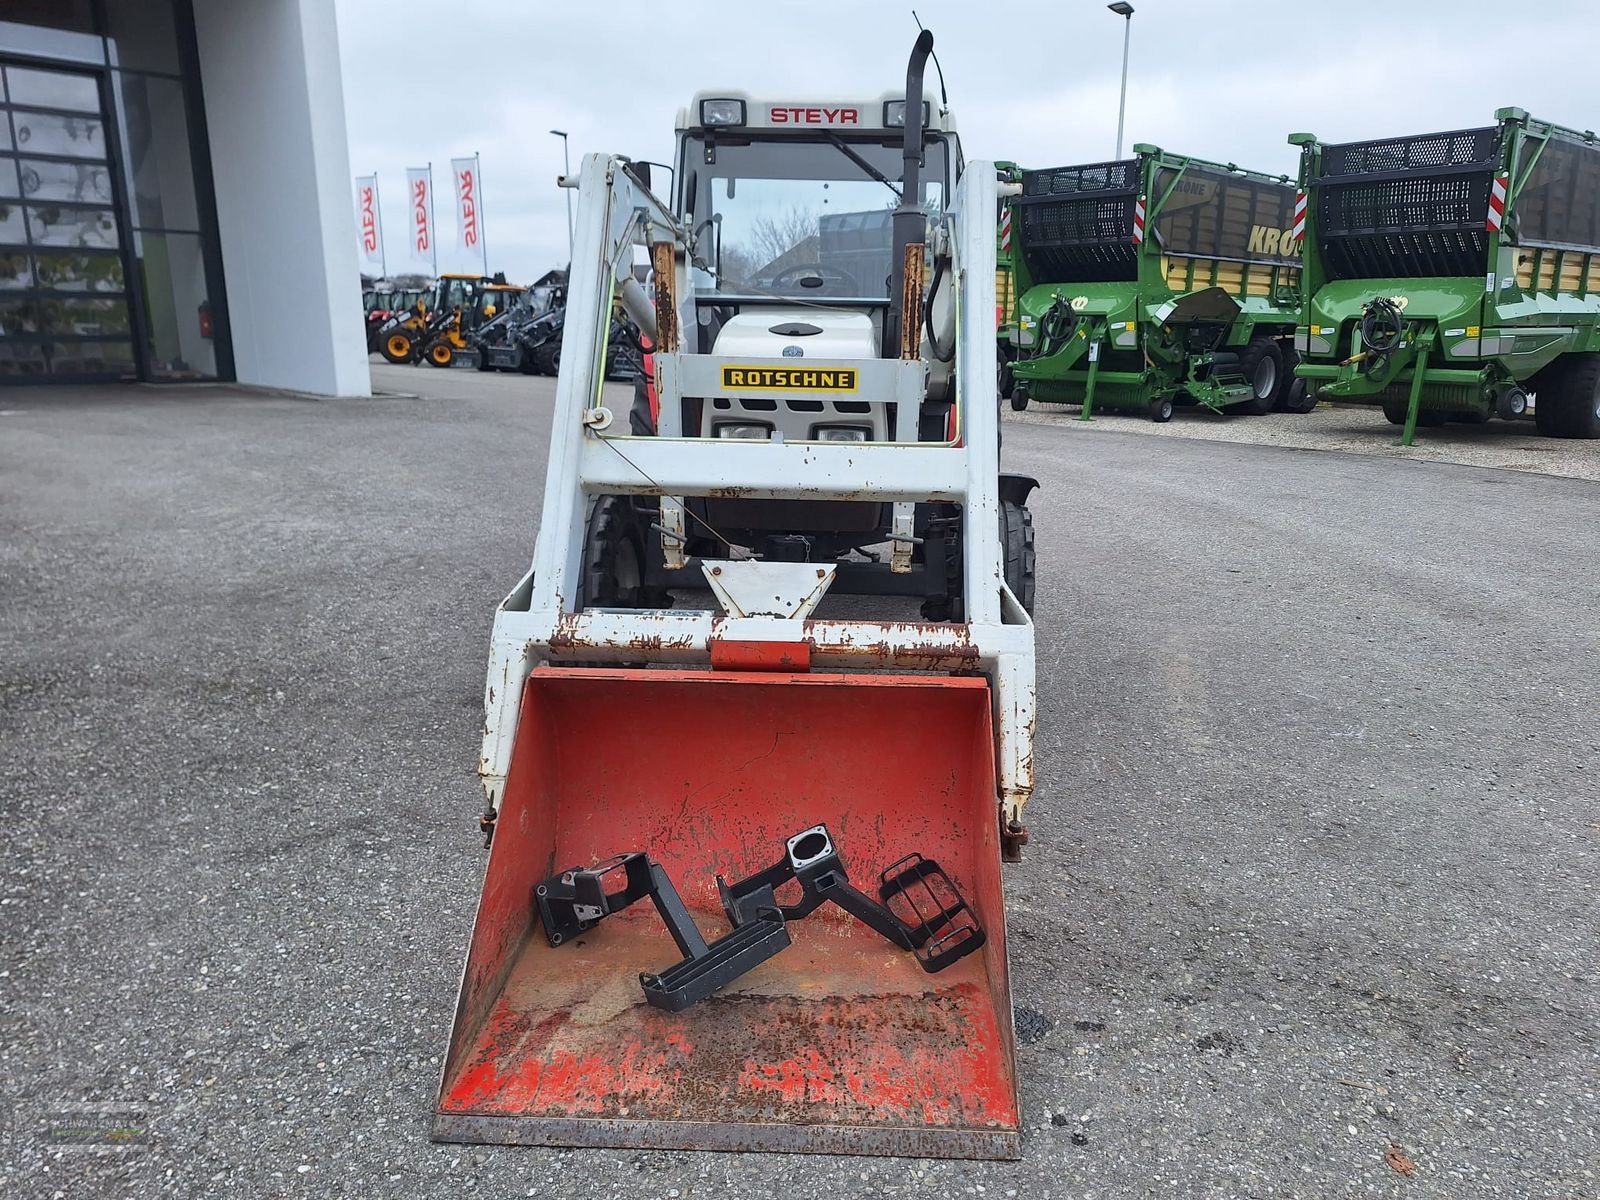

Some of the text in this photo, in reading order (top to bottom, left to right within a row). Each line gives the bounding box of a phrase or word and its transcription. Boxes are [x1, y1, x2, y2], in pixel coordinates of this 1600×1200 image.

[771, 108, 858, 124] STEYR
[1175, 179, 1206, 196] RONE
[1247, 224, 1304, 257] KRO
[731, 370, 849, 387] ROTSCHNE
